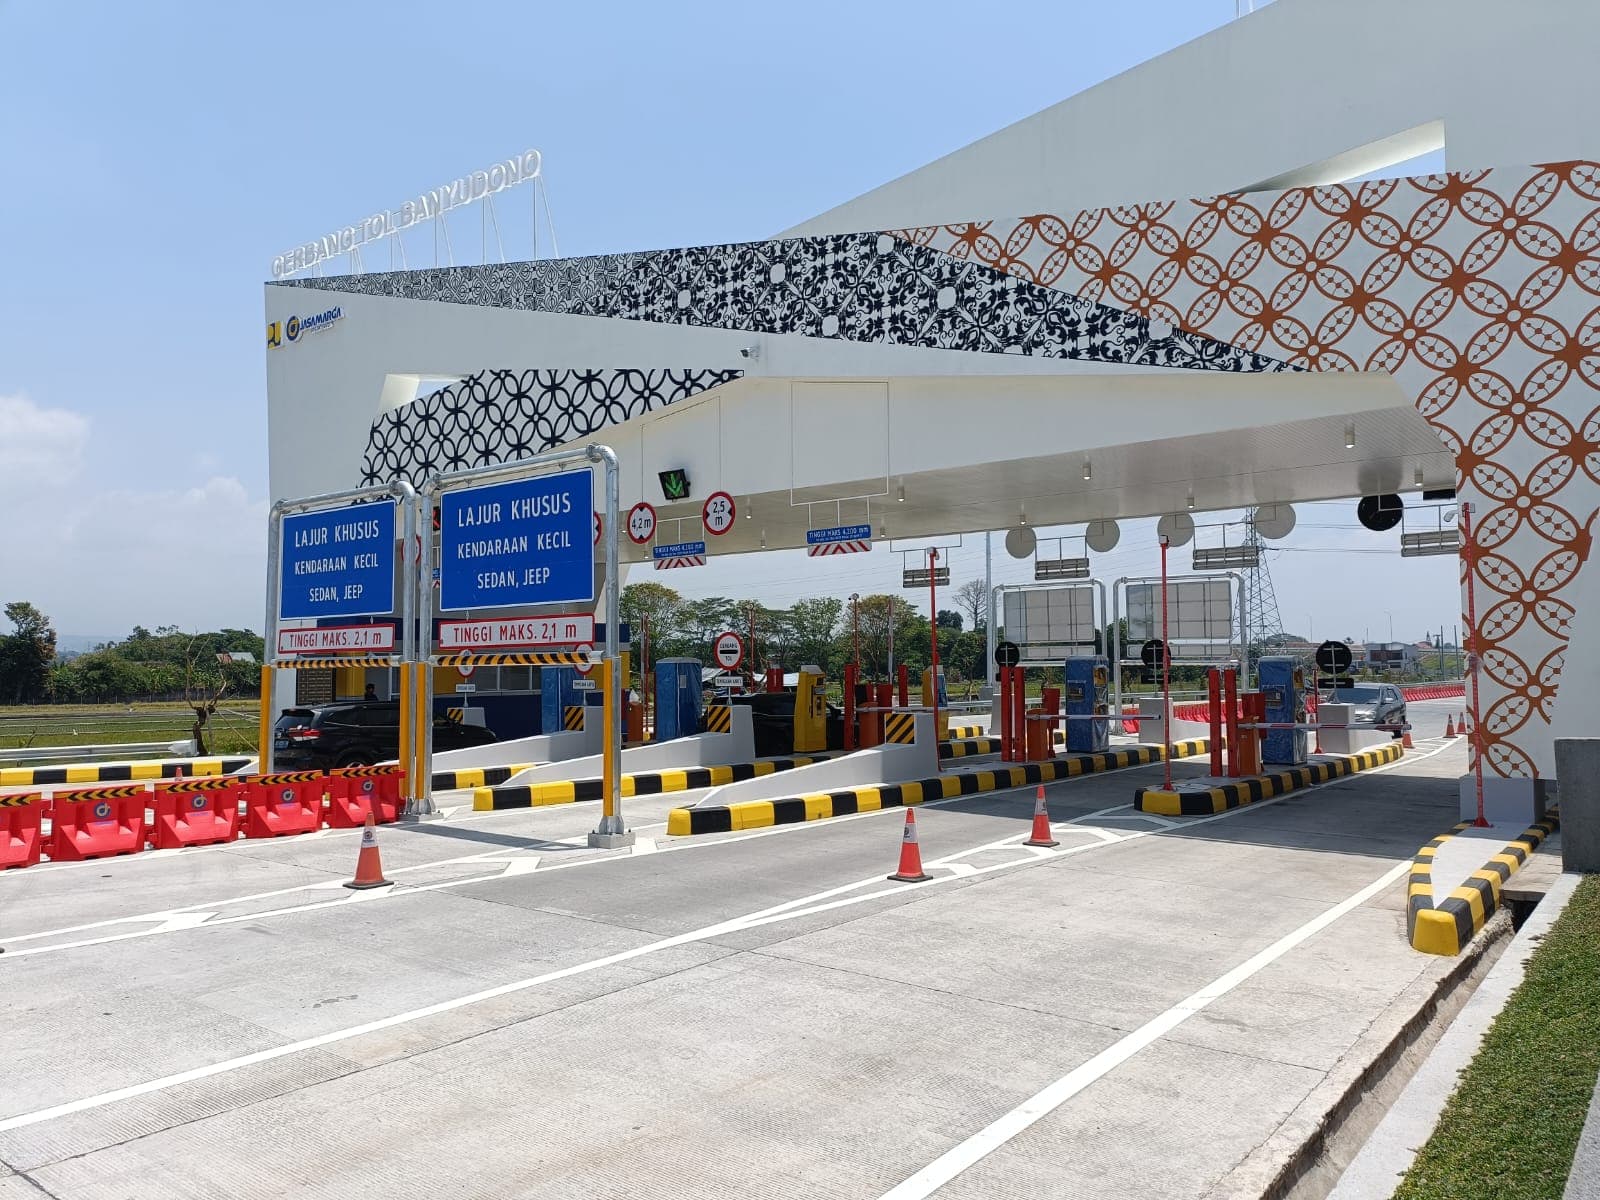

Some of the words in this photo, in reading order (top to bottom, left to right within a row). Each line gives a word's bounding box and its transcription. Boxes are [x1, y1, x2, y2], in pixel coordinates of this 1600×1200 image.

[272, 227, 354, 278] GERBANG
[360, 210, 393, 242] TOL
[400, 148, 542, 228] BANYUDONO
[299, 306, 341, 330] JASAMARGA
[458, 502, 501, 527] LAJUR
[511, 493, 571, 519] KHUSUS
[713, 502, 725, 514] 2,5
[632, 517, 643, 530] 4,2
[644, 518, 652, 528] m
[715, 516, 723, 526] m
[295, 528, 328, 548] LAJUR
[334, 519, 379, 541] KHUSUS
[457, 538, 528, 559] KENDARAAN
[537, 531, 571, 550] KECIL
[294, 557, 347, 576] KENDARAAN
[354, 553, 378, 569] KECIL
[477, 571, 519, 590] SEDAN,
[523, 568, 550, 585] JEEP
[309, 588, 339, 602] SEDAN,
[343, 585, 363, 599] JEEP
[289, 633, 318, 648] TINGGI
[322, 632, 351, 646] MAKS.
[354, 631, 368, 646] 2,1
[372, 632, 382, 644] m
[454, 626, 492, 643] TINGGI
[499, 623, 537, 640] MAKS.
[542, 623, 557, 641] 2,1
[565, 624, 577, 638] m
